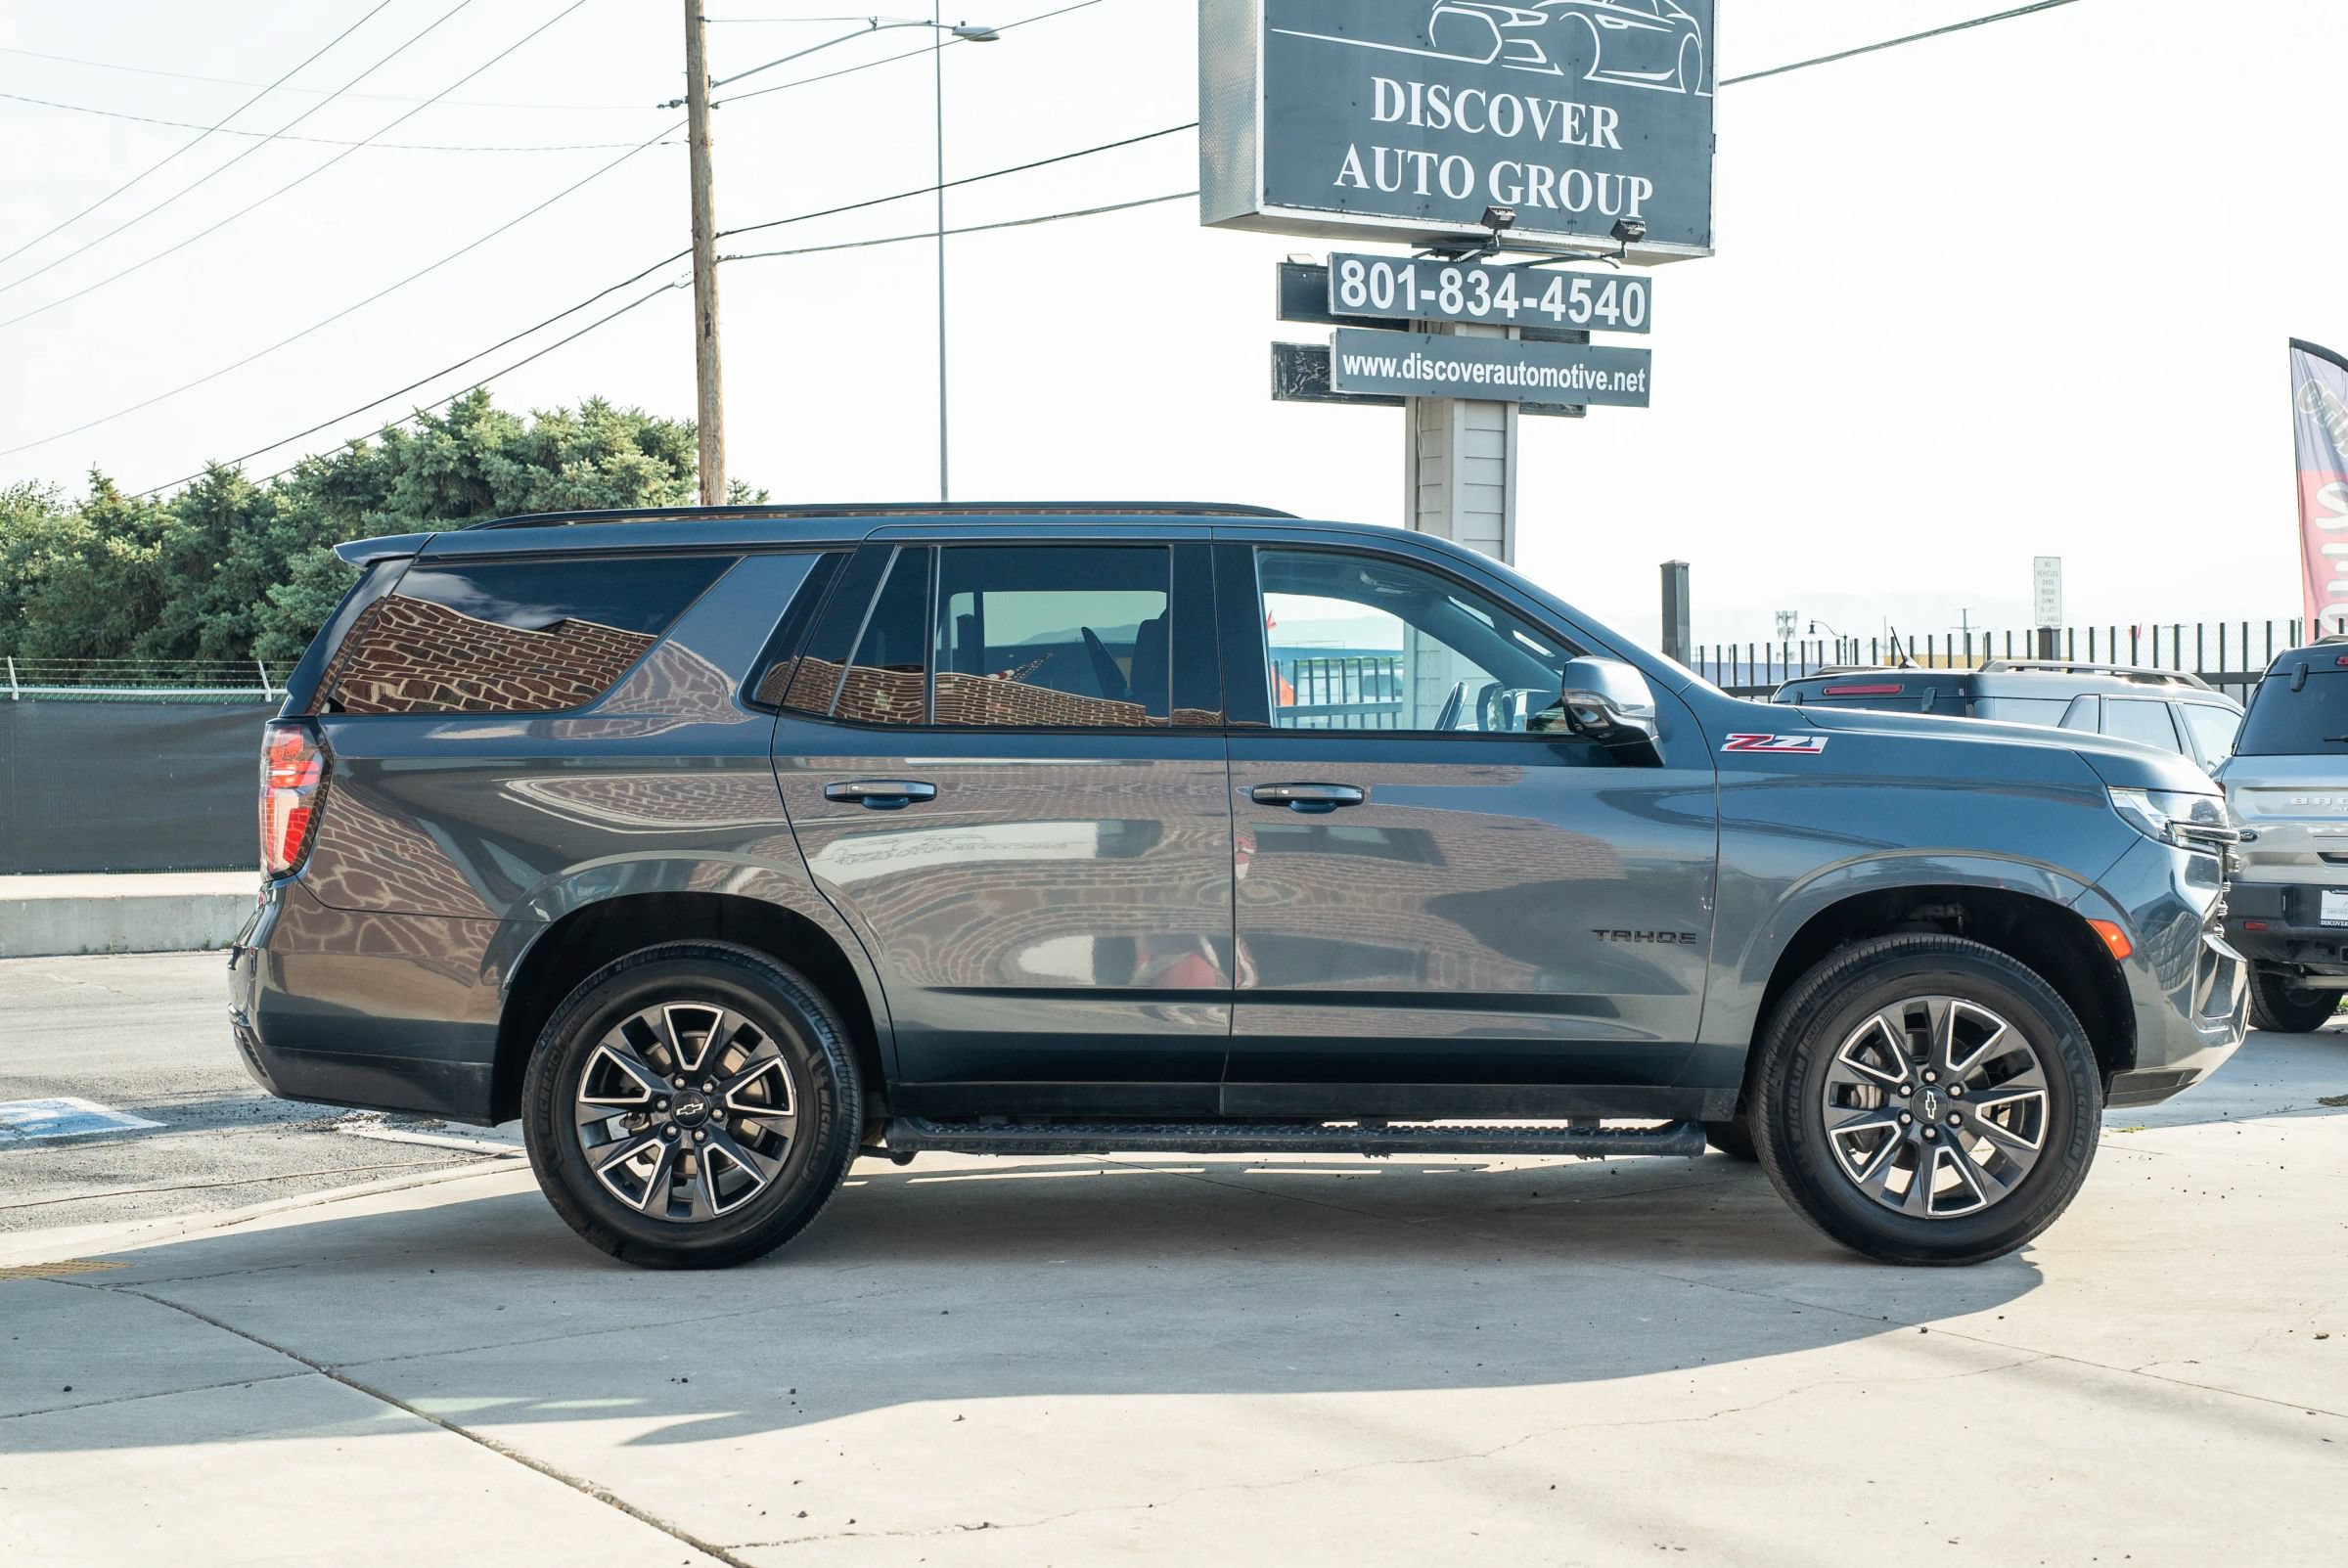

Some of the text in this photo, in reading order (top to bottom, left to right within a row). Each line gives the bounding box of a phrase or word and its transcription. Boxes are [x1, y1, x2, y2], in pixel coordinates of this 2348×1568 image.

[1371, 76, 1623, 150] DISCOVER
[1333, 143, 1653, 218] AUTO GROUP
[1340, 258, 1647, 328] 801-834-4540
[1342, 352, 1646, 393] www.discoverautomotive.net
[1592, 929, 1696, 945] TAHOE
